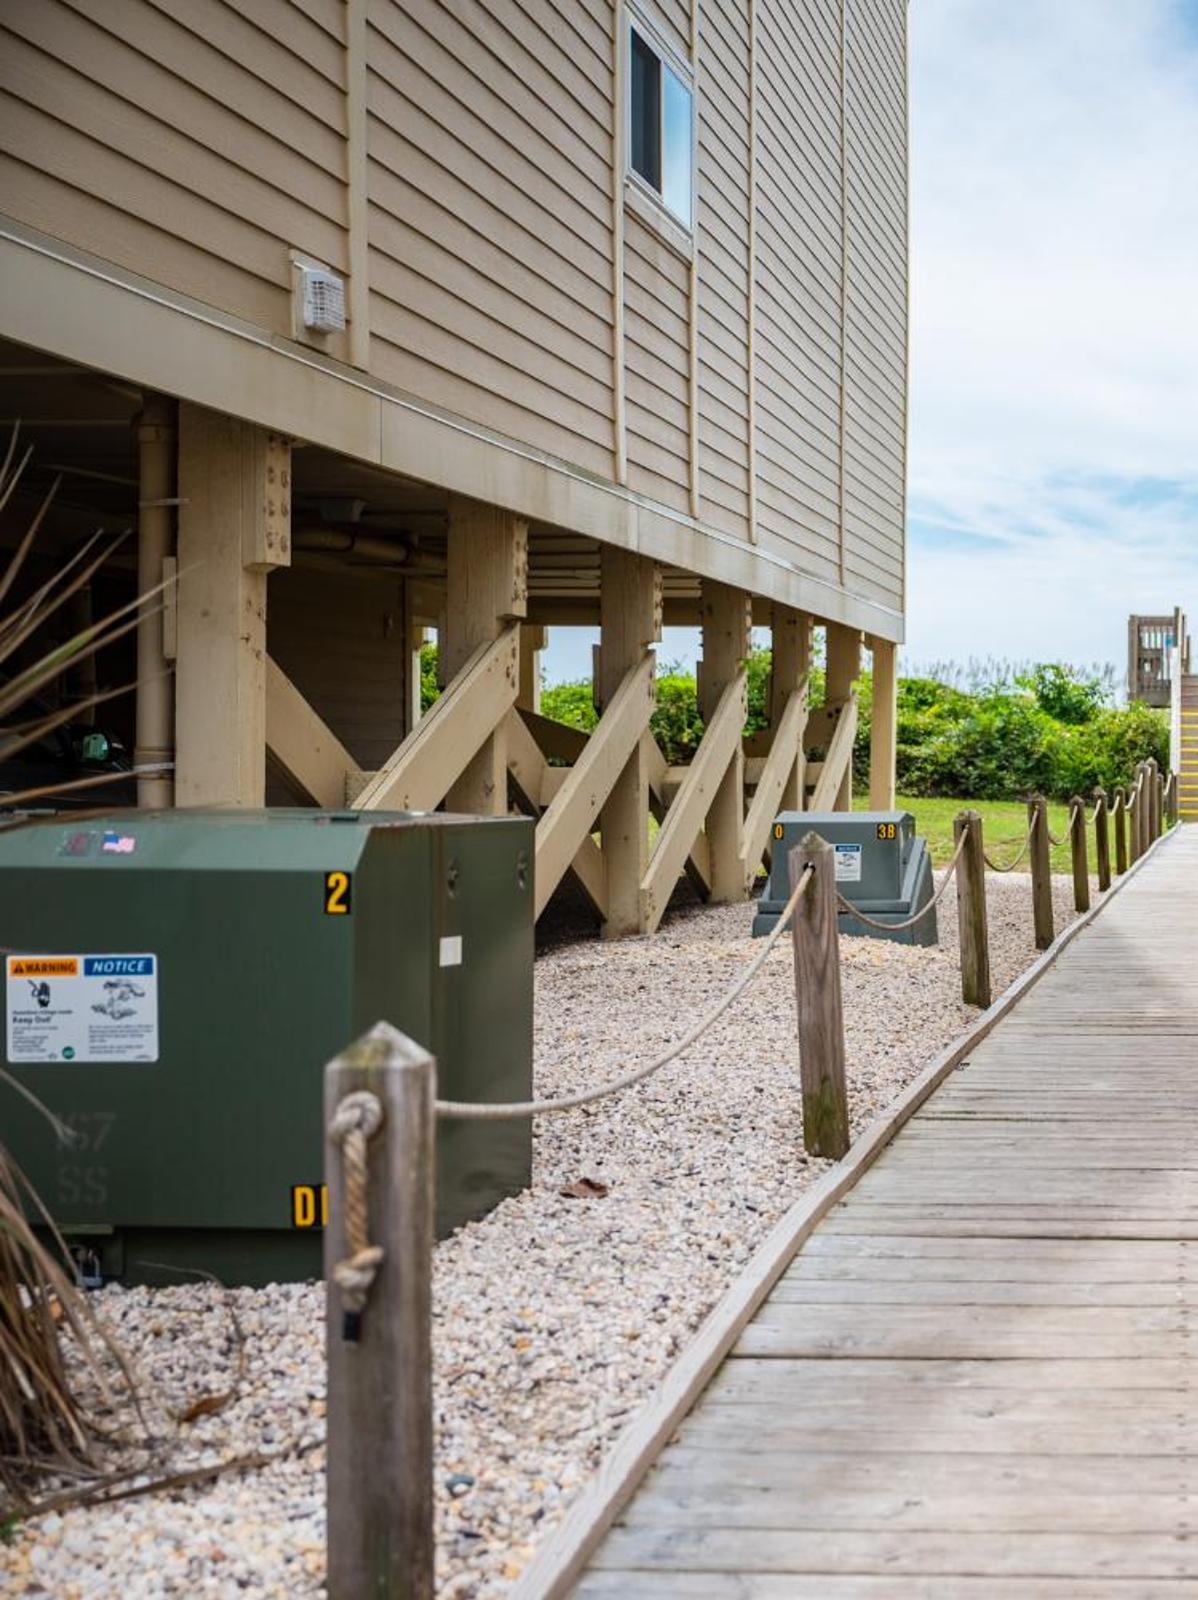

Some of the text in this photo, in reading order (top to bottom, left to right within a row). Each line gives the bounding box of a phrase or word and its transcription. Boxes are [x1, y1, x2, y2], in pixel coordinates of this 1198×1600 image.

[327, 872, 349, 913] 2
[24, 961, 76, 974] WARNING
[92, 960, 147, 973] NOTICE
